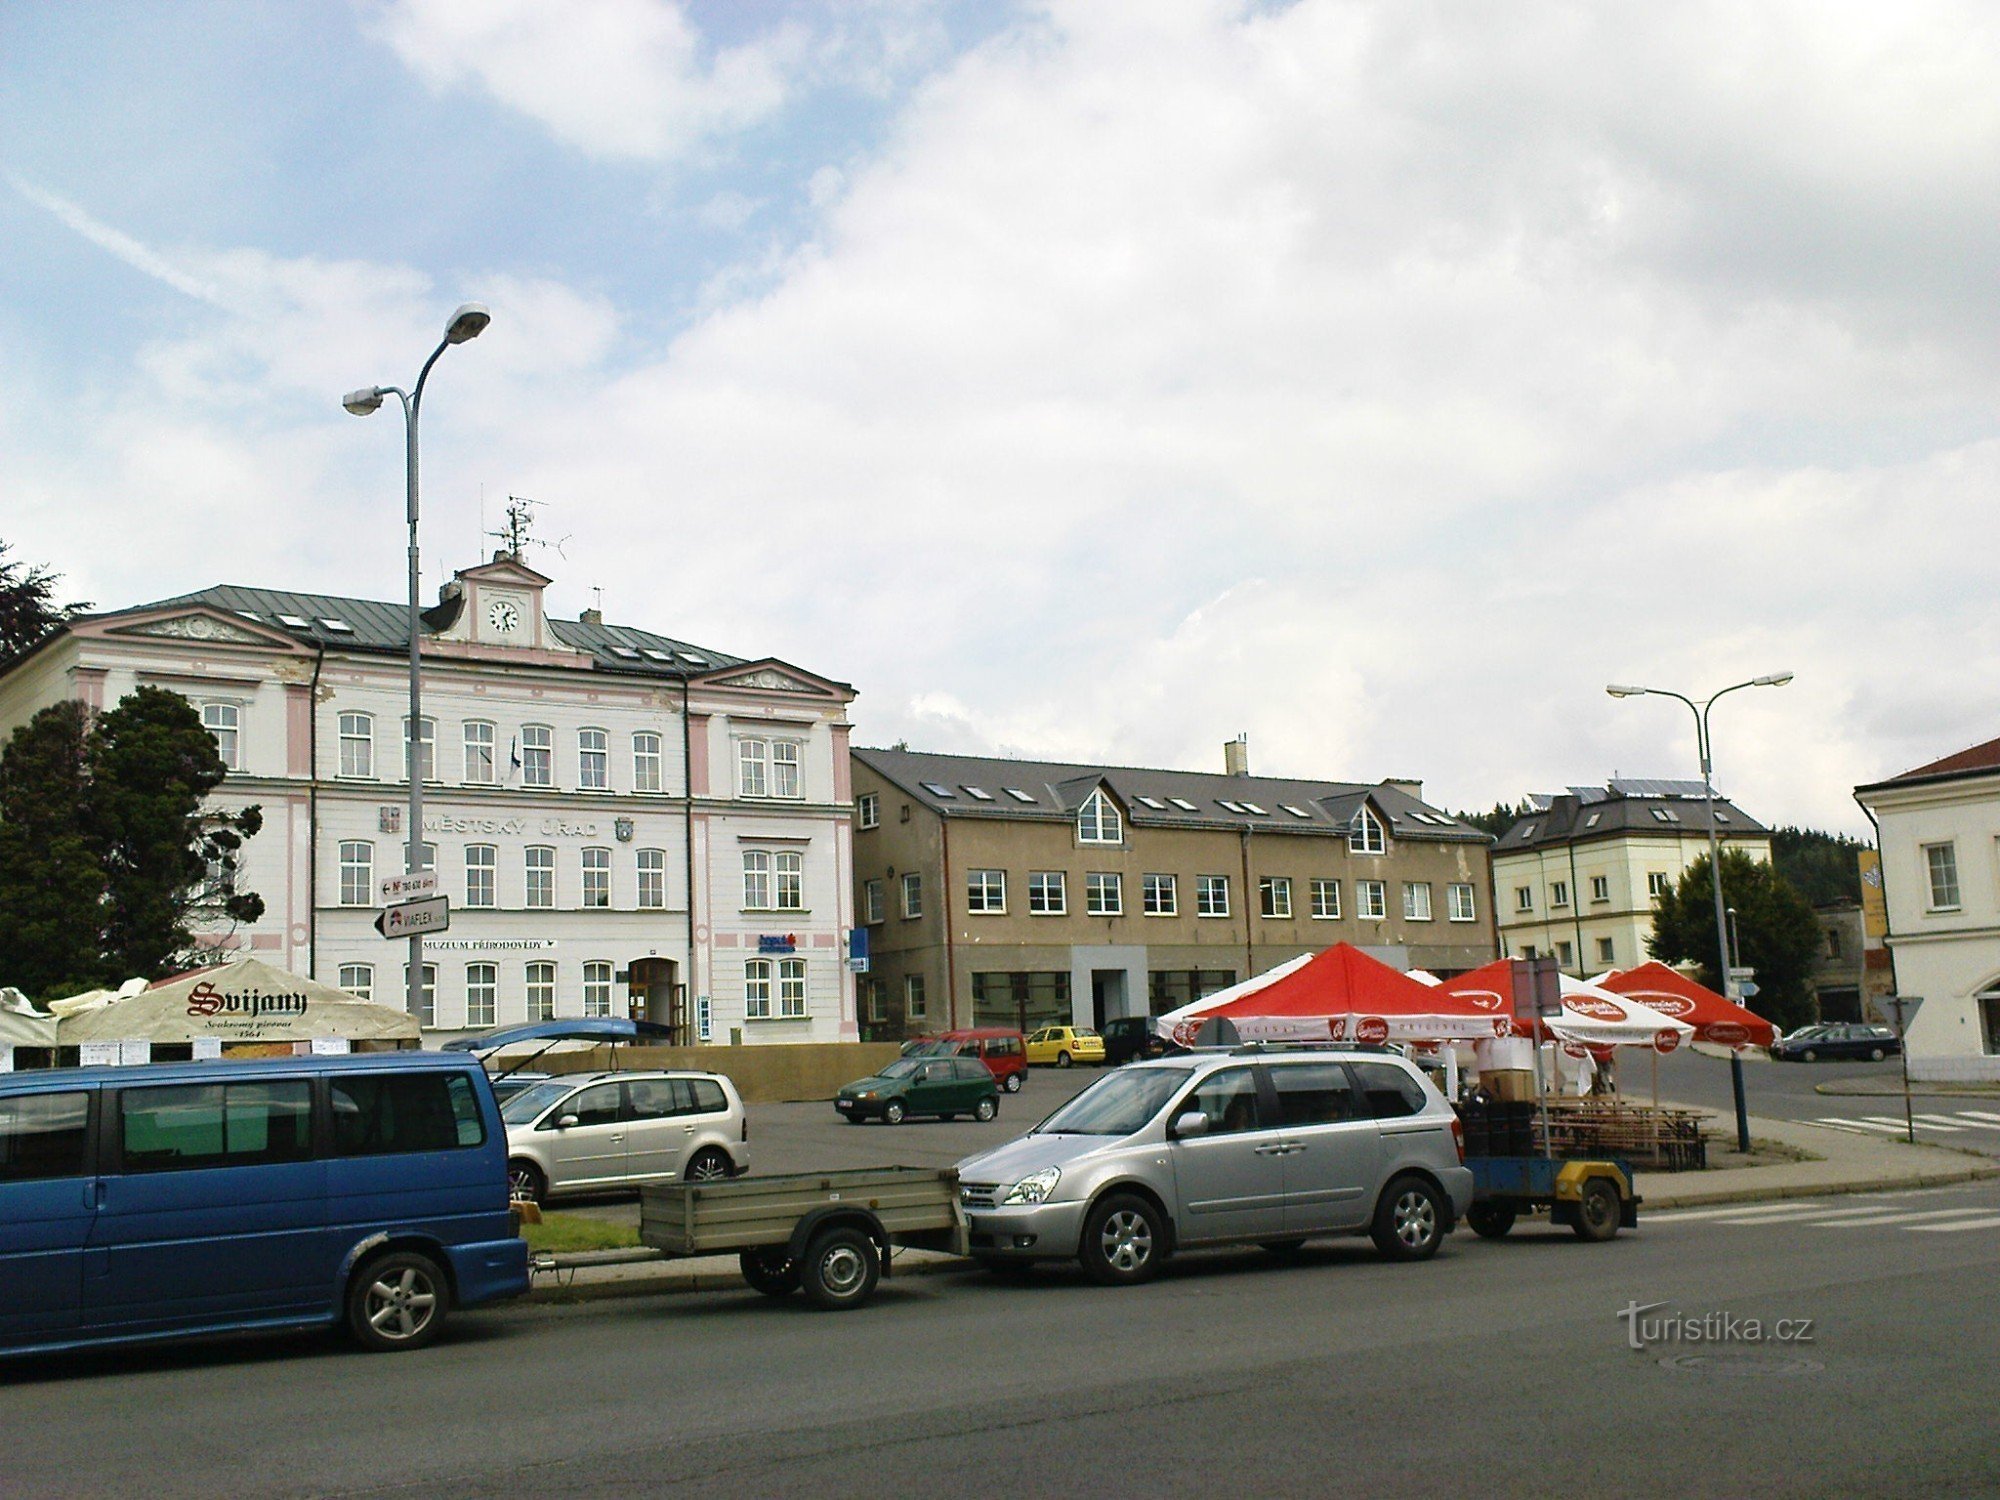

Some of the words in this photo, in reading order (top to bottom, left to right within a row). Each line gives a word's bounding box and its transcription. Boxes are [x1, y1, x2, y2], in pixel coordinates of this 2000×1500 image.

[422, 813, 526, 835] MĚSTSKÝ
[540, 818, 598, 837] ÚŘAD
[423, 941, 469, 950] MUZEUM
[473, 939, 542, 950] PŘÍRODOVĚDY
[187, 981, 308, 1018] Svijany
[1235, 1024, 1300, 1034] RIGINAL
